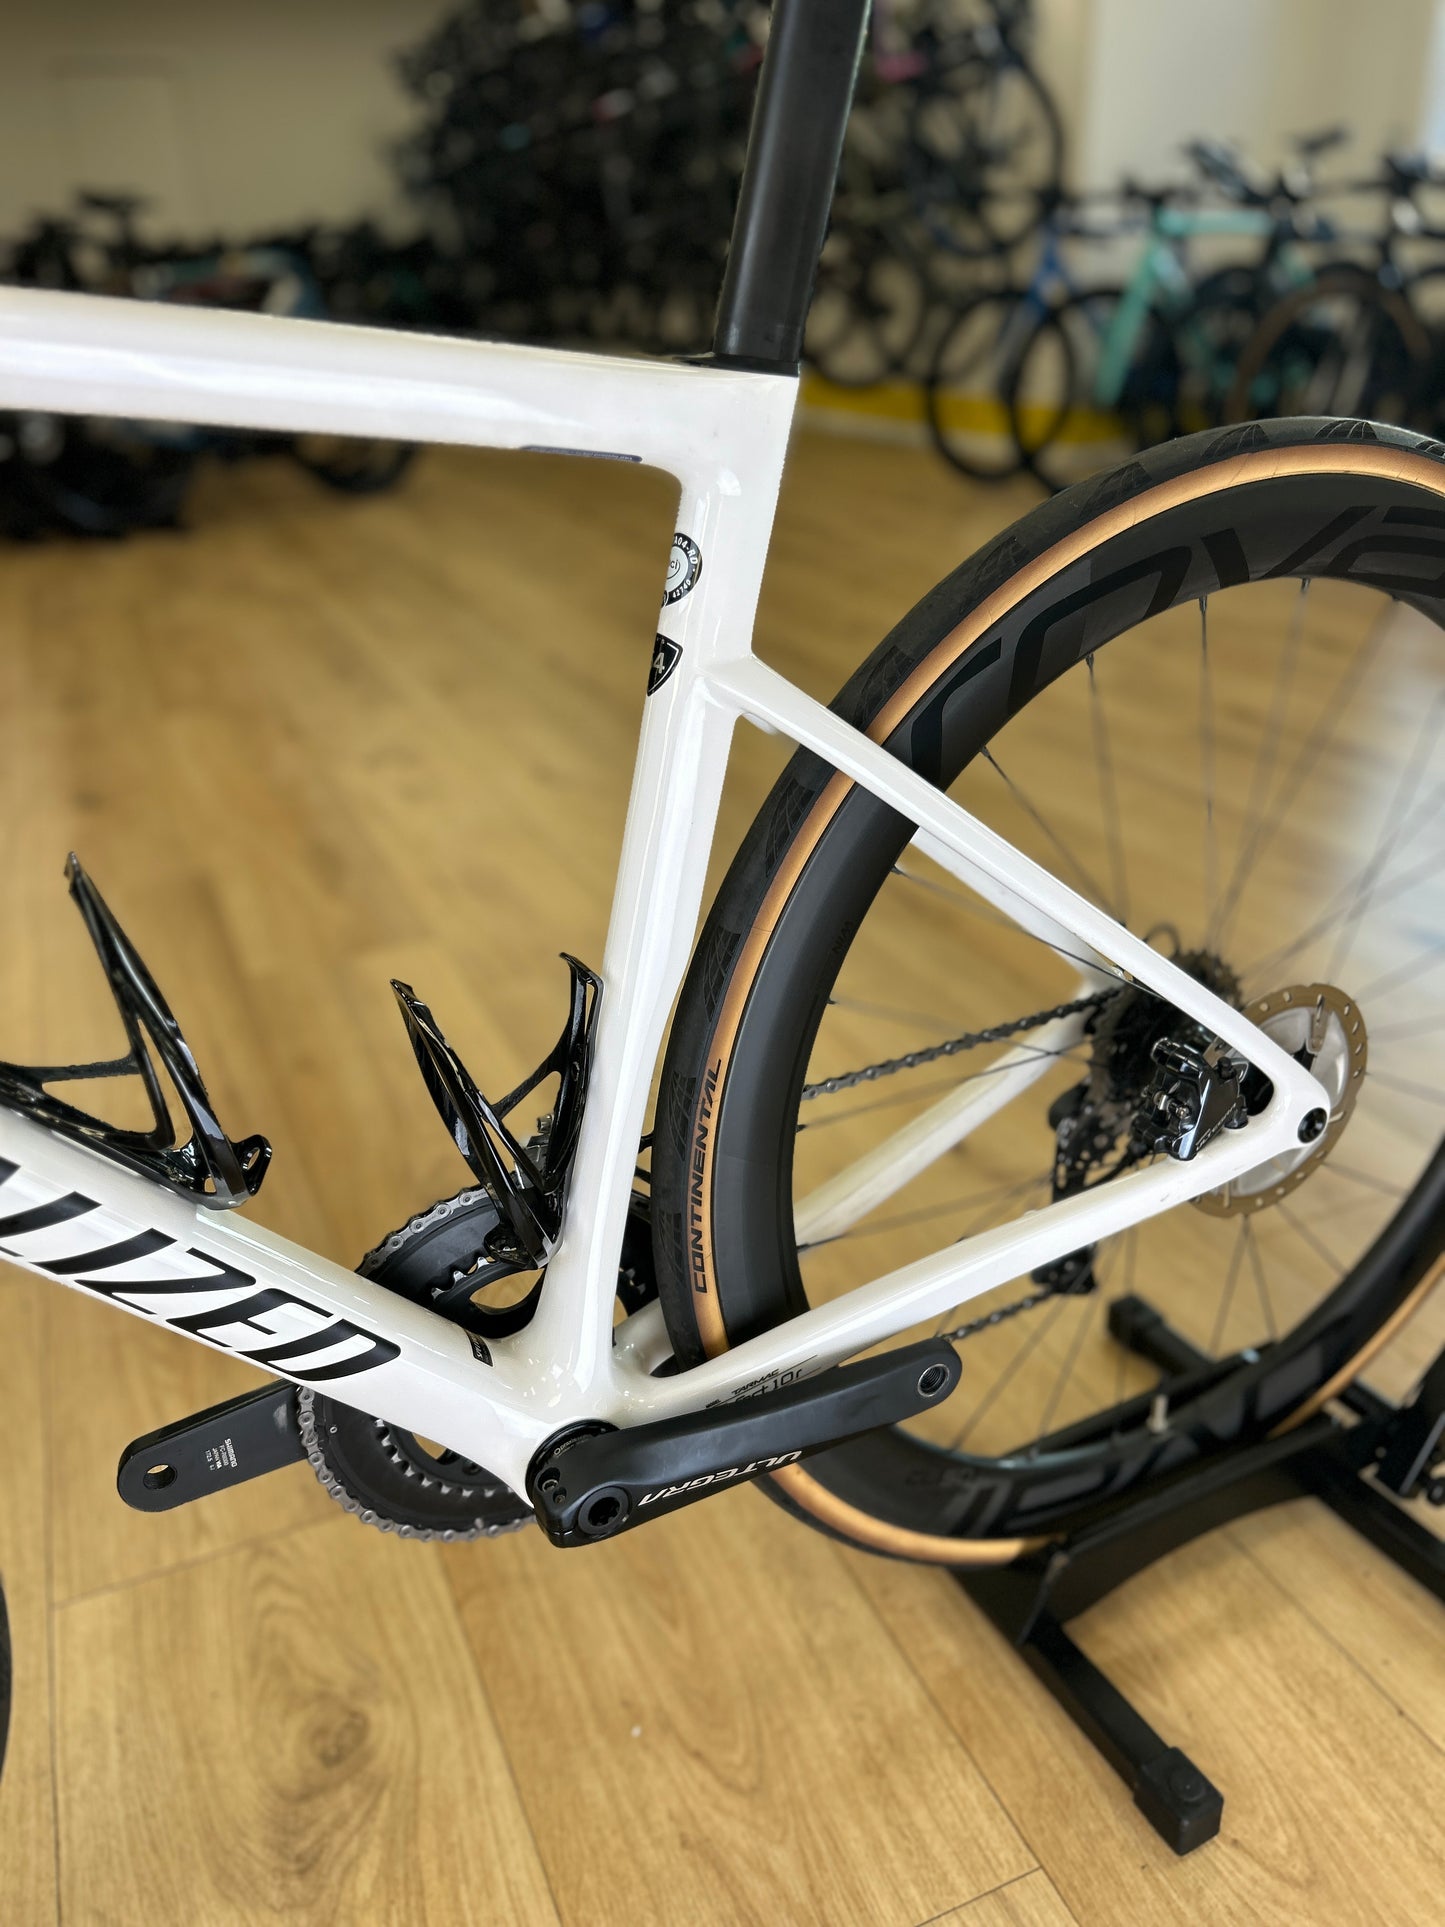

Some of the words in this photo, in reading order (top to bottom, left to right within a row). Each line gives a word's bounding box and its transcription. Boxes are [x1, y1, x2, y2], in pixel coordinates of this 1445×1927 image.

[687, 1058, 722, 1294] CONTINENTAL
[0, 1156, 401, 1382] LIZED
[731, 1368, 780, 1396] TARMAC
[224, 1438, 238, 1468] SHIMANO
[637, 1450, 803, 1507] ULTEGRA
